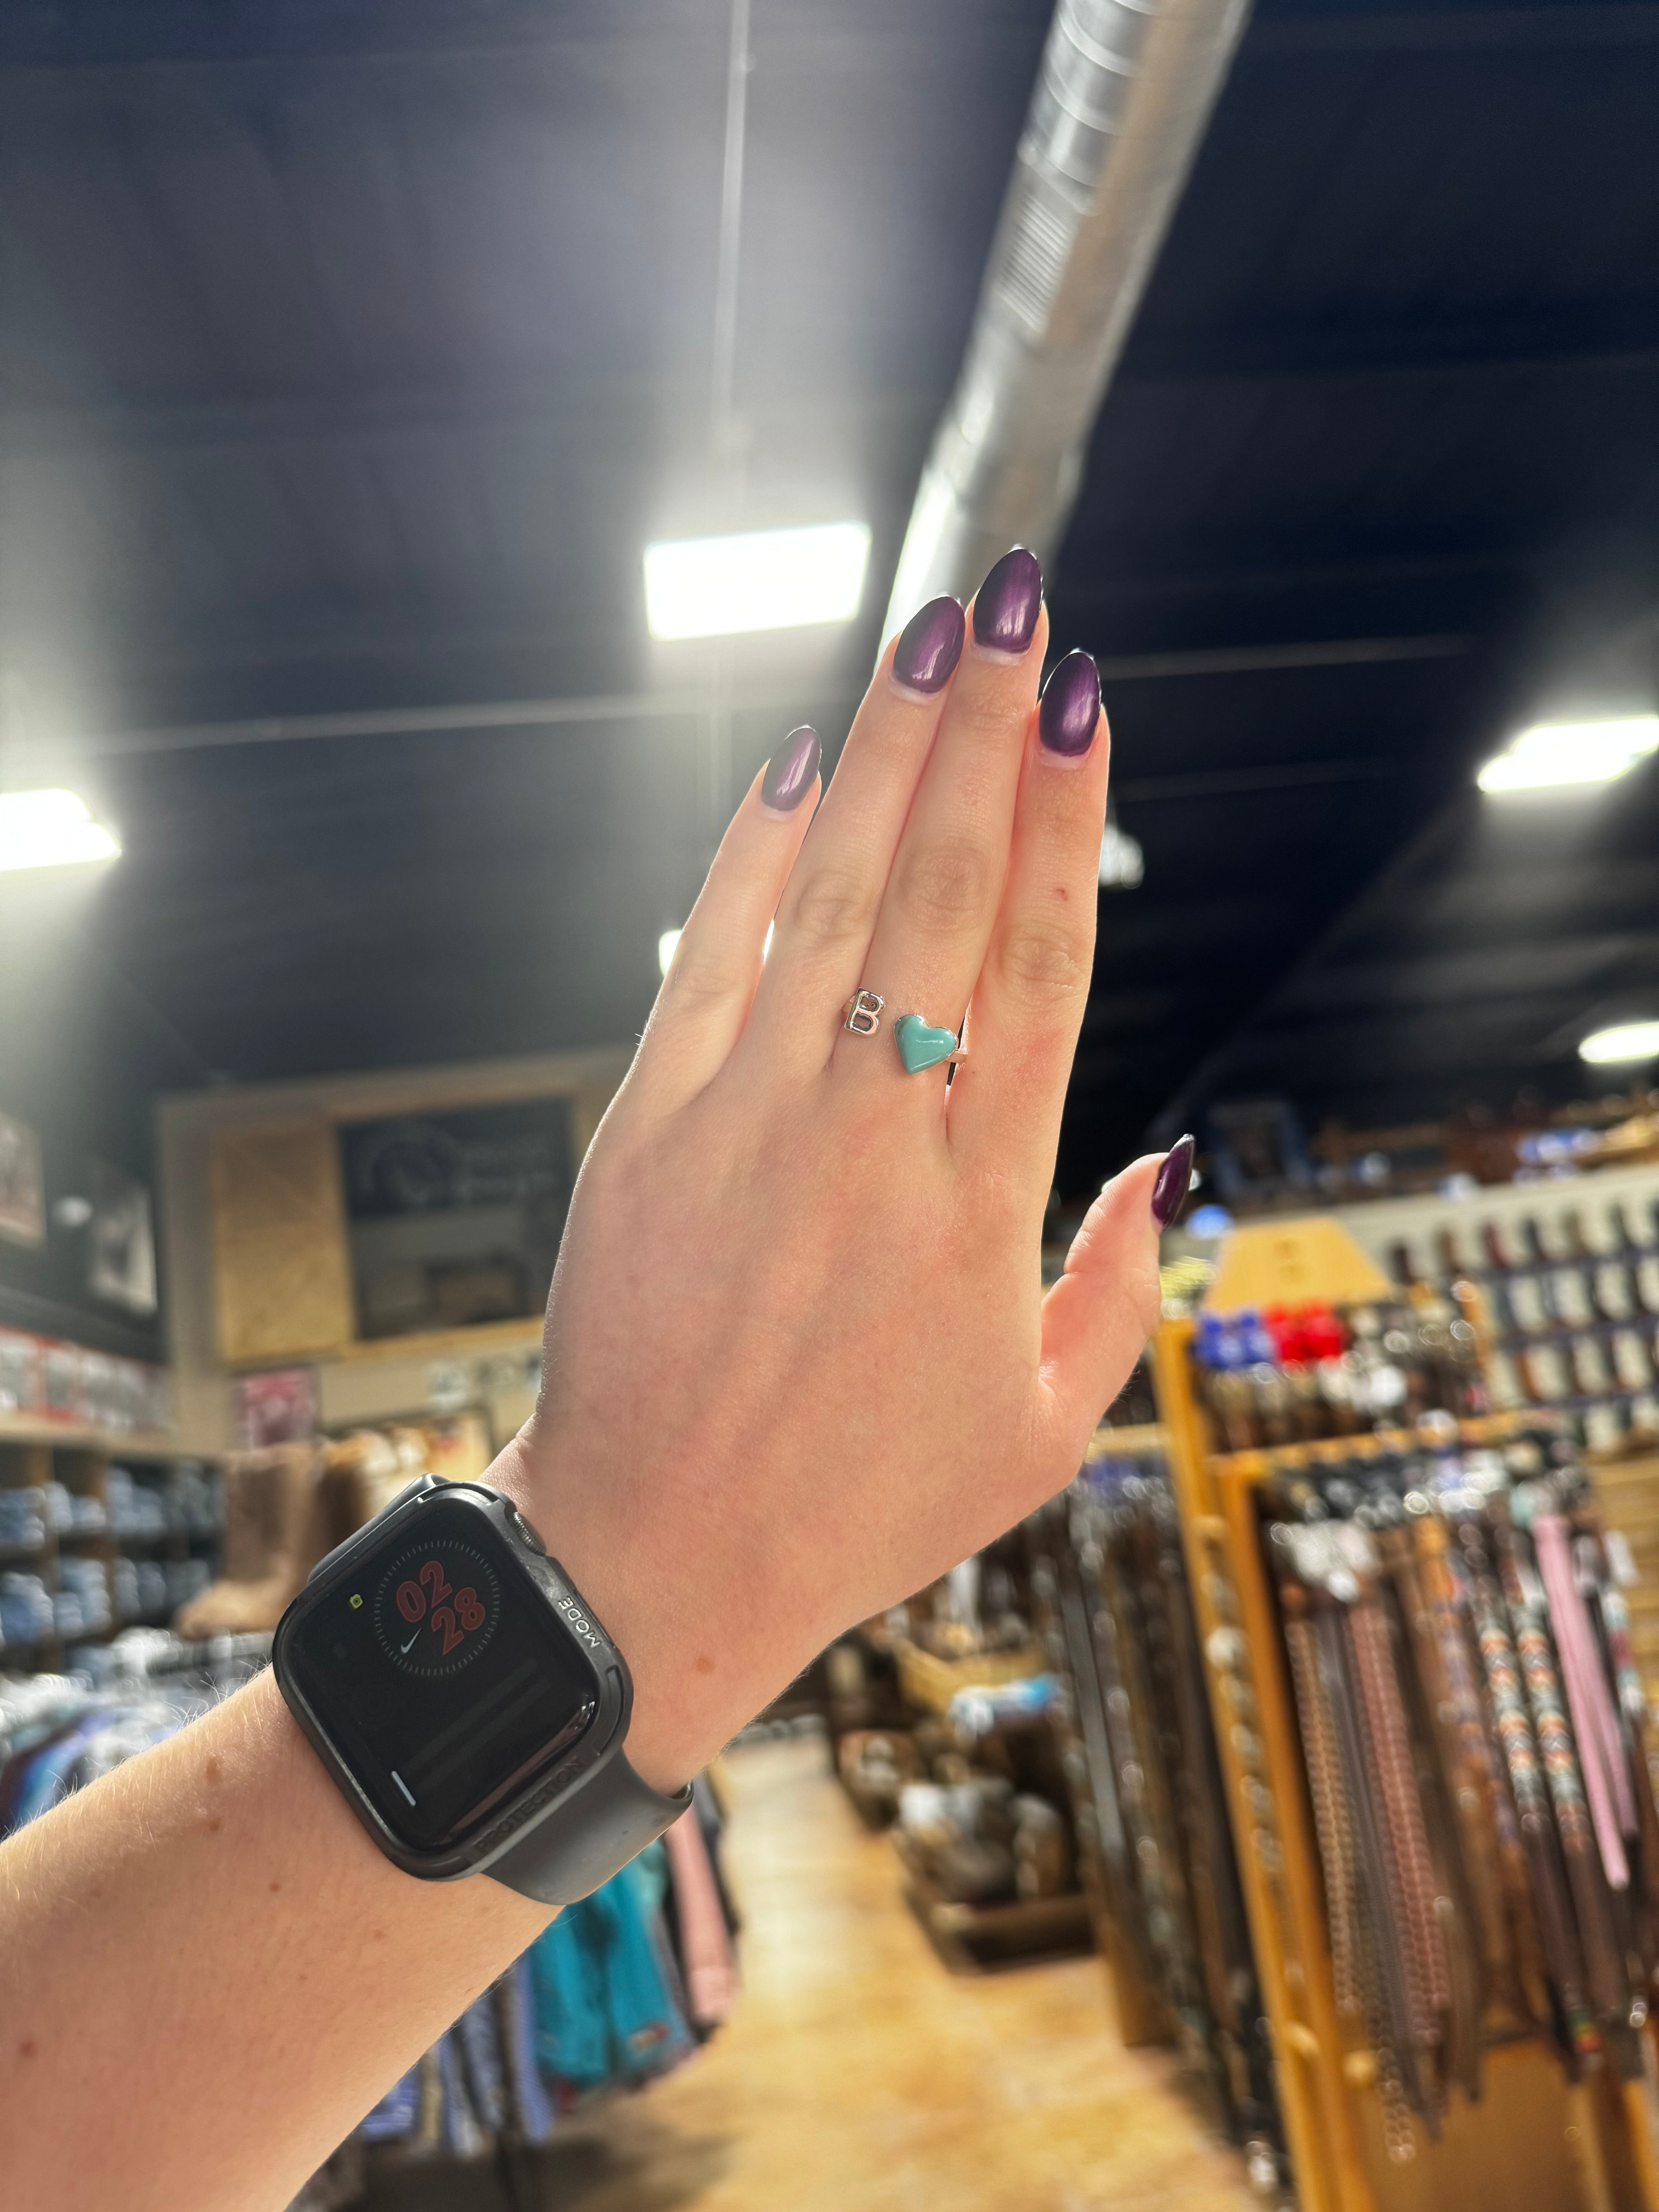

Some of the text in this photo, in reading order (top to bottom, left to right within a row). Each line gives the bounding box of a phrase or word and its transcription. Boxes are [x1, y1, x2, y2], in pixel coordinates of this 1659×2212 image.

[844, 987, 885, 1037] B
[396, 1560, 453, 1623] 02
[431, 1586, 486, 1656] 28
[557, 1597, 601, 1648] MODE
[474, 1761, 586, 1853] PROTECTION
